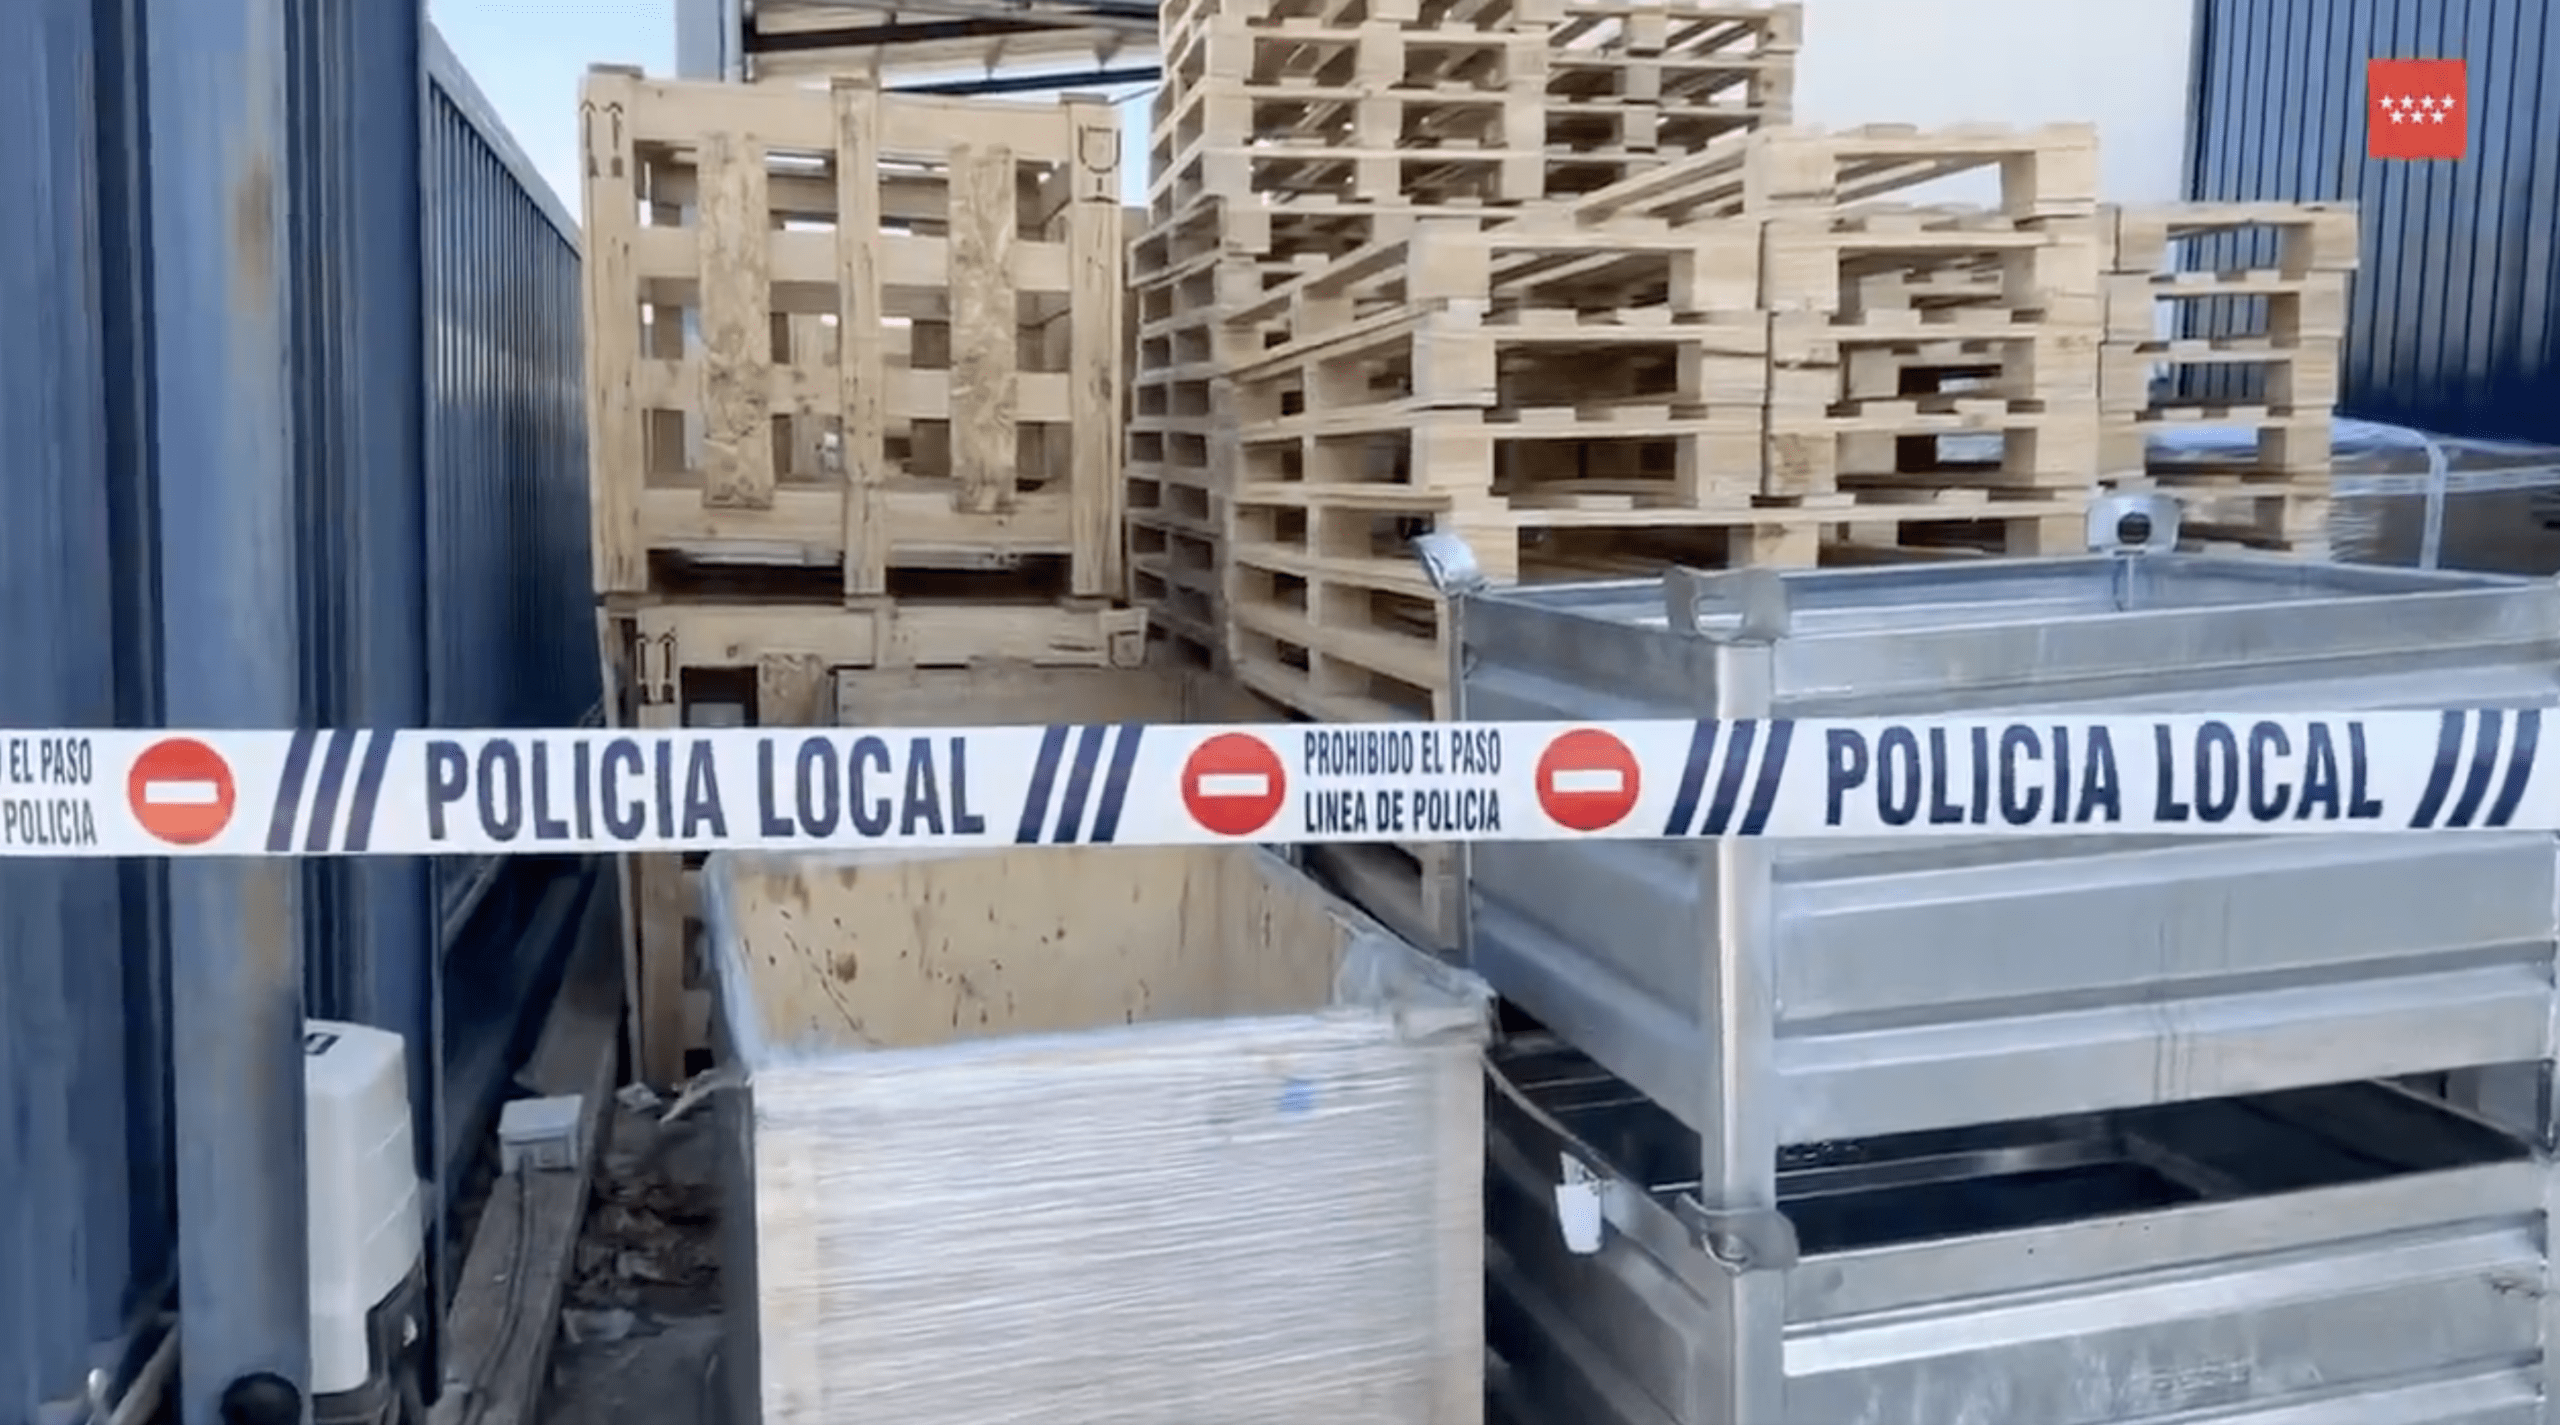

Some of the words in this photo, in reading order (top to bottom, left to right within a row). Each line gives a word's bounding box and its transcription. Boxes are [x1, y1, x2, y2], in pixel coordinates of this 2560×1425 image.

[9, 738, 34, 783] EL
[41, 738, 92, 785] PASO
[1304, 730, 1414, 776] PROHIBIDO
[1421, 730, 1444, 774] EL
[1450, 729, 1502, 774] PASO
[1825, 724, 2121, 827] POLICIA
[2153, 719, 2384, 824] LOCAL
[425, 738, 728, 842] POLICIA
[757, 735, 986, 838] LOCAL
[1304, 790, 1368, 834] LINEA
[1376, 789, 1405, 833] DE
[1412, 788, 1501, 833] POLICIA
[3, 799, 98, 845] POLICIA
